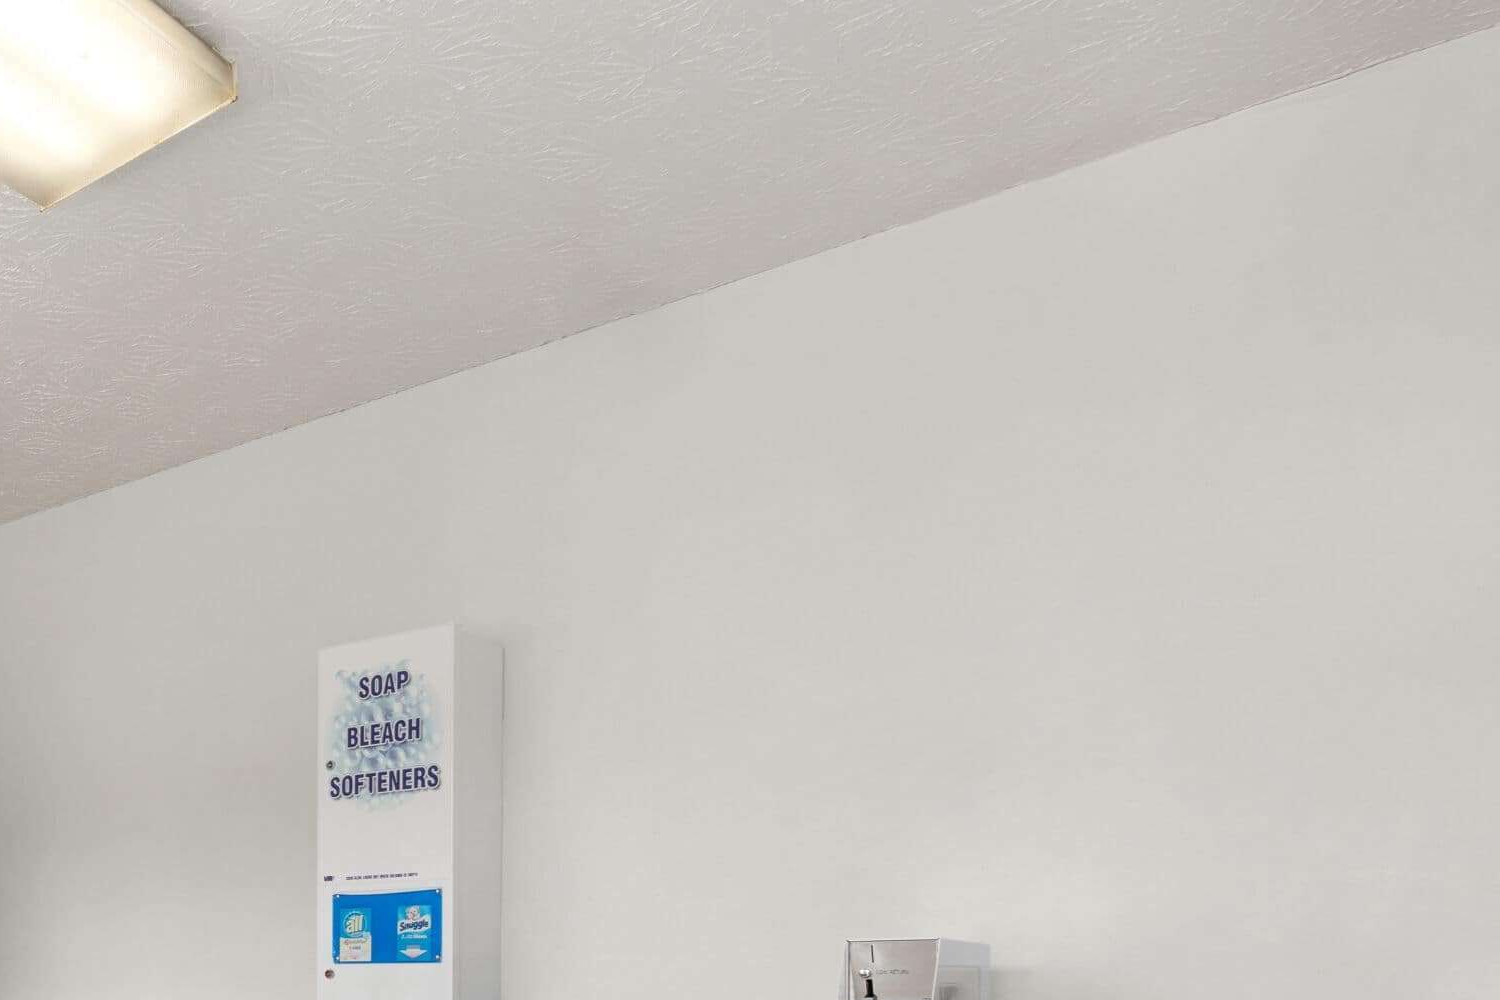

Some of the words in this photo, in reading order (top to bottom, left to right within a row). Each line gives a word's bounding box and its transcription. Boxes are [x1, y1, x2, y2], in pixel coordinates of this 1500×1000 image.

[359, 671, 409, 699] SOAP
[347, 718, 421, 748] BLEACH
[330, 765, 439, 798] SOFTENERS
[399, 920, 428, 932] Snuggle
